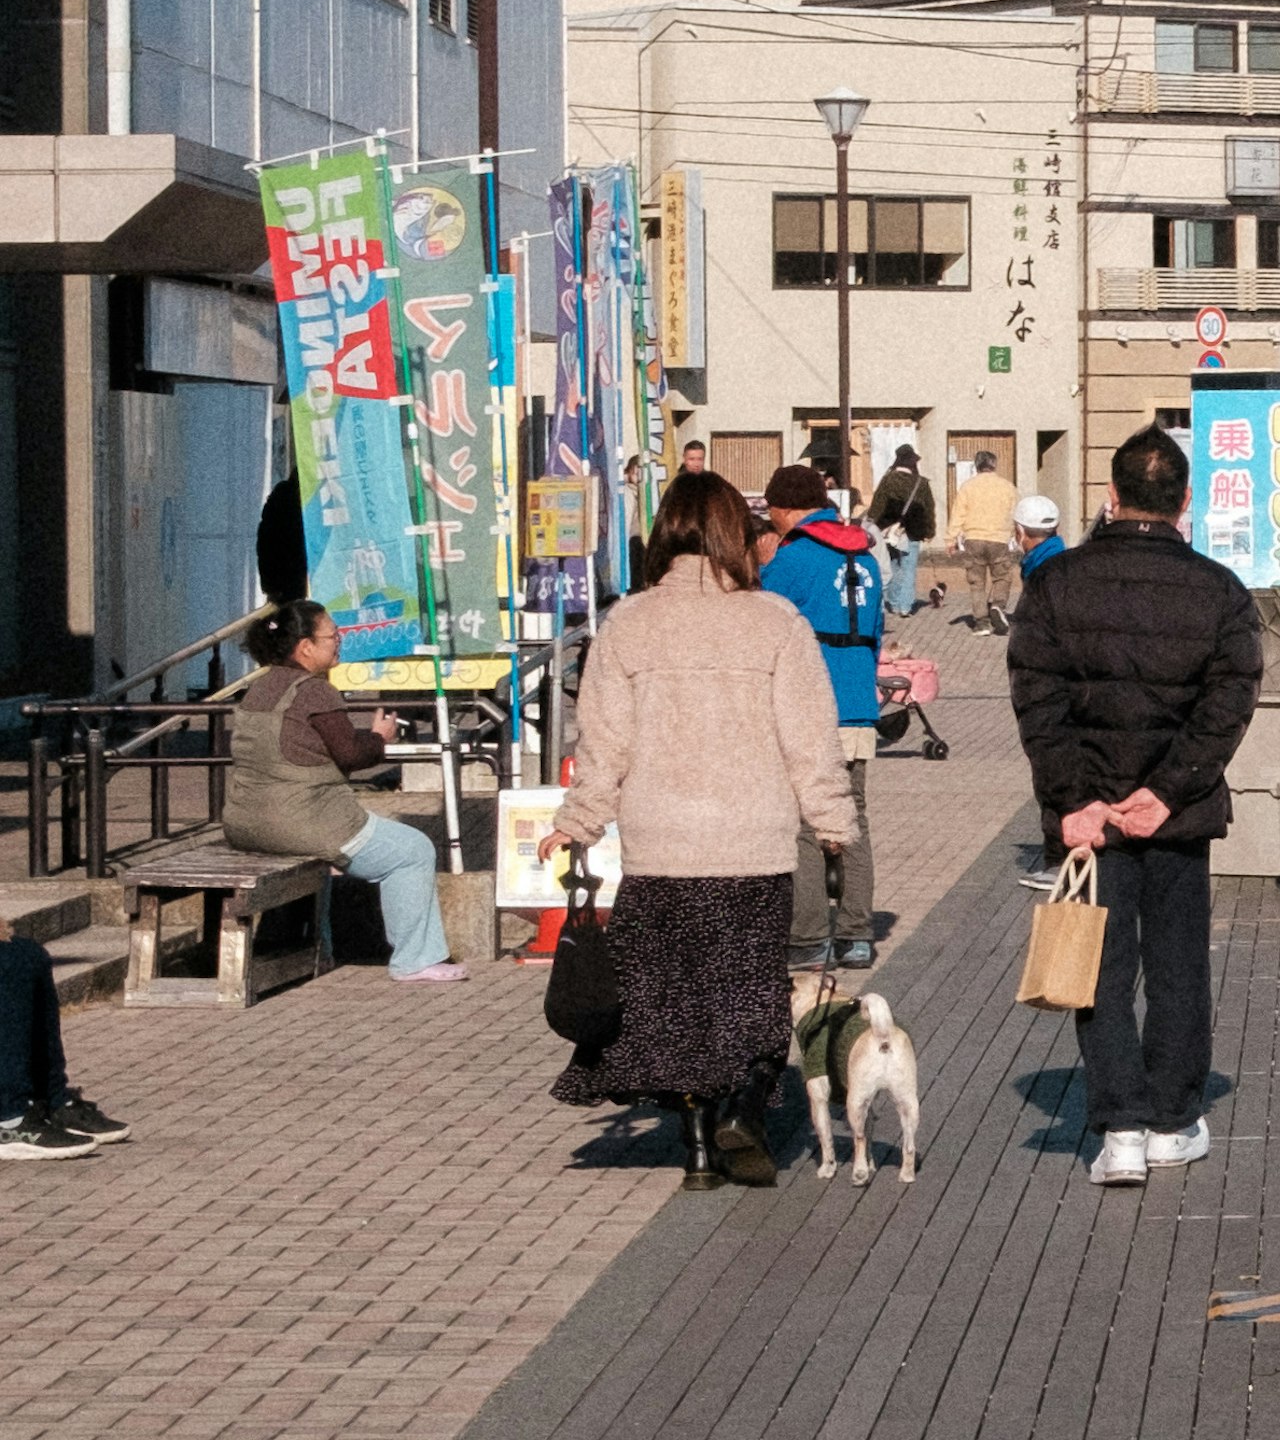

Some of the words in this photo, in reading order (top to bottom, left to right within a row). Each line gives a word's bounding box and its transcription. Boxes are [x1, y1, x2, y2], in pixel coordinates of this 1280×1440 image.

[1005, 254, 1036, 342] はな
[1202, 317, 1220, 336] 30
[1212, 422, 1251, 509] 乗船
